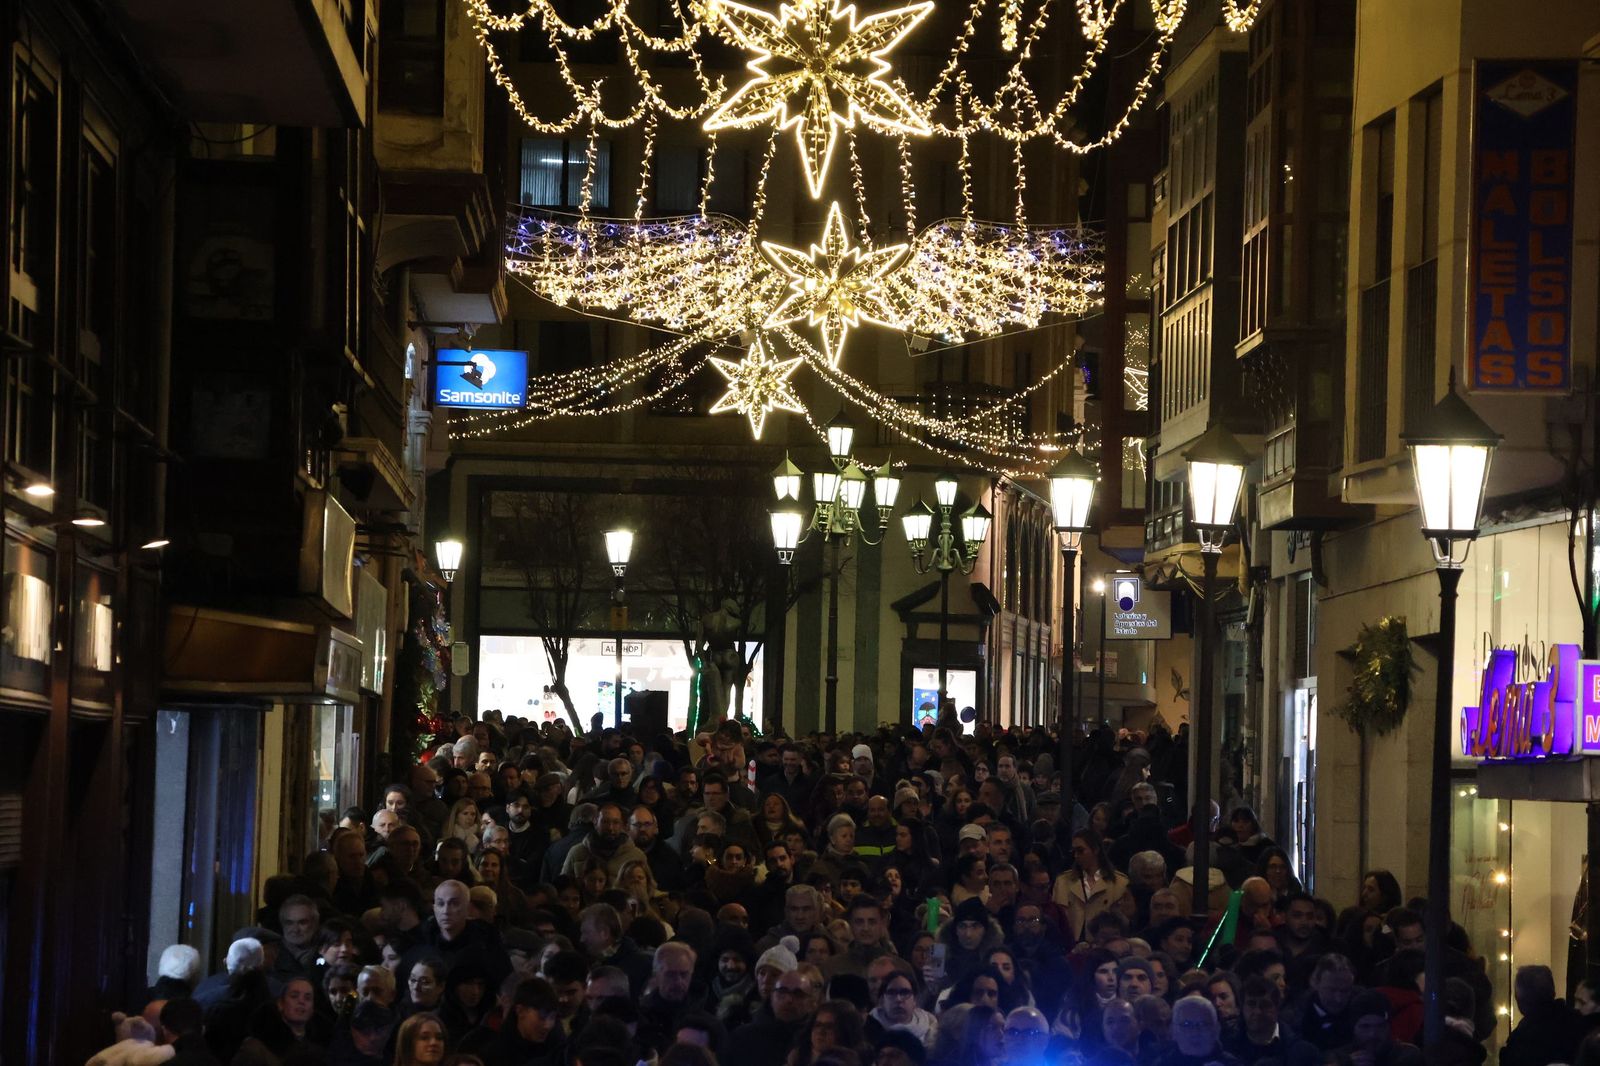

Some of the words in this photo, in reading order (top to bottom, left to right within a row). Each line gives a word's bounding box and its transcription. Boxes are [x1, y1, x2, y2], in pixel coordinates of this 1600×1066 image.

[1479, 148, 1520, 386] MALETAS
[1526, 148, 1569, 386] BOLSOS
[440, 389, 521, 404] Samsonite
